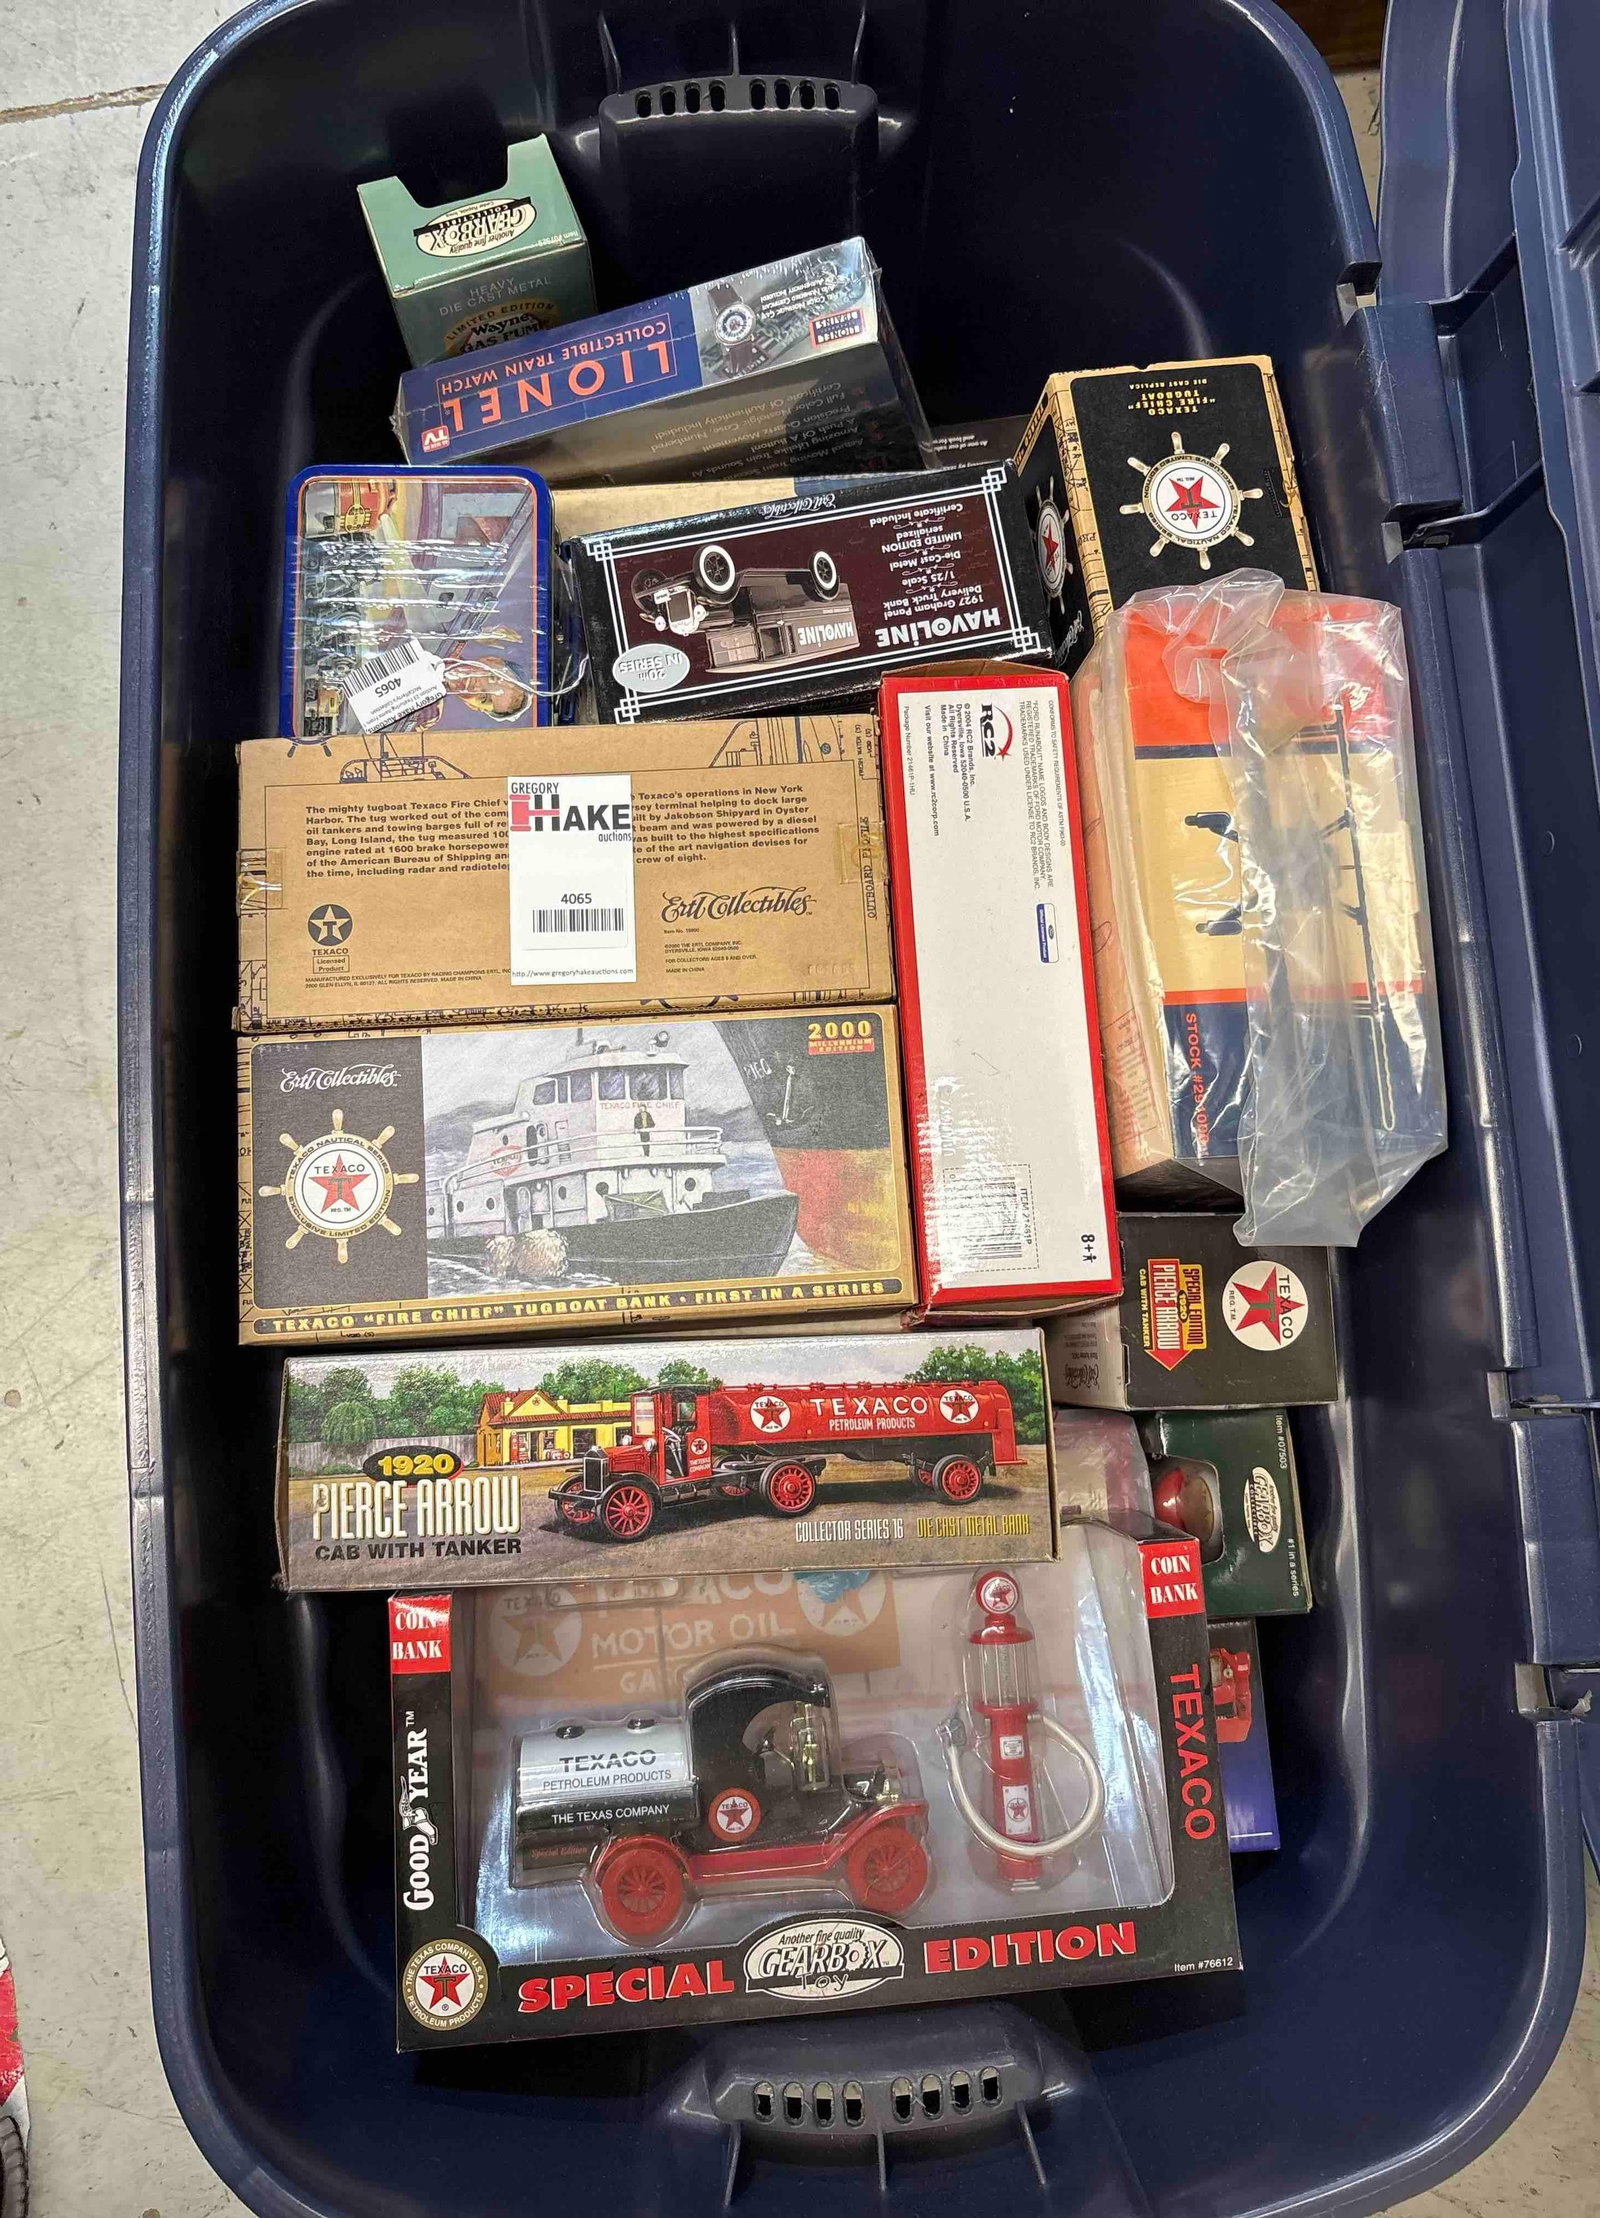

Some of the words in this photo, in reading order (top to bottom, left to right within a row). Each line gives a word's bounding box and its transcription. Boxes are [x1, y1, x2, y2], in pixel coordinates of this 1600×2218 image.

[430, 207, 528, 250] GEARBOX
[439, 305, 463, 316] DIE
[467, 293, 502, 307] CAST
[508, 278, 550, 296] METAL
[470, 277, 515, 297] HEAVY
[447, 311, 497, 340] LIMITED
[501, 302, 555, 313] EDITION
[471, 313, 530, 336] Wayne
[503, 324, 541, 344] PUM
[562, 320, 667, 361] COLLECTIBLE
[506, 353, 554, 376] TRAIN
[442, 370, 498, 395] WATCH
[443, 341, 671, 432] LIONEL
[1129, 381, 1165, 390] REPLICA
[770, 399, 784, 407] Of
[793, 382, 841, 404] Certificate
[1141, 390, 1199, 400] TUGBOAT
[705, 403, 766, 425] Authenticity
[1148, 406, 1198, 416] TEXACO
[423, 431, 448, 445] TV
[869, 512, 911, 527] Included
[914, 503, 963, 517] Certificate
[1171, 510, 1218, 521] TEXACO
[897, 525, 943, 541] serialized
[924, 531, 962, 545] LIMITED
[882, 539, 921, 553] EDITION
[890, 559, 918, 571] Metal
[920, 550, 961, 564] Die-Cast
[902, 576, 928, 586] Scale
[931, 571, 955, 582] 1/25
[913, 593, 939, 604] Truck
[941, 585, 982, 598] Delivery
[958, 594, 984, 607] 1927
[883, 598, 909, 609] Bank
[915, 600, 955, 613] Graham
[884, 607, 912, 621] Panel
[798, 616, 854, 646] HAVOLINE
[875, 607, 1001, 647] HAVOLINE
[619, 656, 663, 673] SERIES
[665, 652, 682, 665] IN
[639, 667, 667, 681] 20th
[374, 677, 402, 698] 4065
[981, 703, 995, 758] RC2
[511, 782, 560, 794] GREGORY
[638, 792, 683, 800] Texaco's
[685, 789, 740, 799] operations
[754, 786, 771, 794] New
[780, 785, 803, 793] York
[306, 806, 325, 814] The
[328, 805, 364, 814] mighty
[367, 803, 407, 812] tugboat
[411, 802, 448, 810] Texaco
[473, 799, 501, 807] Chief
[534, 794, 631, 831] HAKE
[929, 773, 939, 837] www.rc2corp.com
[599, 830, 632, 842] auctions
[561, 893, 592, 904] 4065
[661, 891, 707, 923] Ertl
[707, 886, 816, 920] Collectibles
[312, 948, 349, 956] TEXACO
[512, 967, 634, 978] http://www.gregoryhakeauctions.com
[808, 1020, 872, 1040] 2000
[809, 1038, 874, 1048] MILLENNIUM
[1186, 1013, 1202, 1069] STOCK
[280, 1068, 317, 1093] Ertl
[315, 1063, 401, 1090] Collectibles
[313, 1163, 366, 1175] TEXACO
[1081, 1234, 1095, 1252] 8+
[1139, 1268, 1147, 1288] CAB
[1153, 1264, 1178, 1306] PIERCE
[1183, 1268, 1201, 1307] SPECIAL
[272, 1315, 355, 1333] TEXACO
[513, 1298, 608, 1316] TUGBOAT
[616, 1293, 671, 1310] BANK
[695, 1290, 752, 1305] FIRST
[761, 1288, 782, 1300] IN
[792, 1286, 804, 1299] A
[812, 1282, 885, 1297] SERIES
[1140, 1288, 1148, 1311] WITH
[1179, 1294, 1188, 1320] 1920
[1278, 1274, 1294, 1339] TEXACO
[1141, 1311, 1150, 1348] TANKER
[1155, 1307, 1181, 1350] ARROW
[1187, 1307, 1204, 1345] EDITION
[810, 1395, 928, 1417] TEXACO
[828, 1418, 873, 1431] PETROLEUM
[876, 1417, 916, 1429] PRODUCTS
[1276, 1415, 1284, 1435] Item
[1276, 1435, 1288, 1469] #07503
[378, 1454, 455, 1476] 1920
[312, 1480, 408, 1541] PIERCE
[417, 1476, 521, 1538] ARROW
[1252, 1474, 1274, 1546] GEARBOX
[795, 1520, 851, 1543] COLLECTOR
[854, 1518, 891, 1541] SERIES
[892, 1518, 904, 1539] 16
[916, 1517, 934, 1538] DIE
[935, 1516, 962, 1537] CAST
[964, 1515, 1000, 1536] METAL
[1002, 1514, 1031, 1535] BANK
[315, 1544, 360, 1562] CAB
[368, 1542, 424, 1560] WITH
[432, 1538, 522, 1557] TANKER
[1286, 1538, 1295, 1549] #1
[1151, 1554, 1191, 1576] COIN
[1289, 1551, 1296, 1560] in
[1291, 1569, 1299, 1597] series
[1150, 1583, 1198, 1605] BANK
[395, 1611, 437, 1630] COIN
[591, 1618, 714, 1658] MOTOR
[730, 1610, 796, 1641] OIL
[392, 1640, 442, 1660] BANK
[559, 1750, 657, 1773] TEXACO
[1170, 1664, 1216, 1840] TEXACO
[543, 1775, 610, 1791] PETROLEUM
[613, 1769, 672, 1785] PRODUCTS
[551, 1813, 574, 1824] THE
[577, 1809, 613, 1821] TEXAS
[615, 1804, 670, 1818] COMPANY
[721, 1801, 749, 1810] TEXACO
[779, 1930, 814, 1945] Another
[814, 1928, 832, 1944] fine
[833, 1927, 864, 1943] quality
[518, 1959, 735, 2014] SPECIAL
[924, 1921, 1136, 1974] EDITION
[761, 1939, 883, 1978] GEARBOX
[1173, 1961, 1196, 1972] Item
[1197, 1957, 1234, 1970] #76612
[423, 1964, 467, 1974] TEXACO
[798, 1973, 848, 1992] Toy
